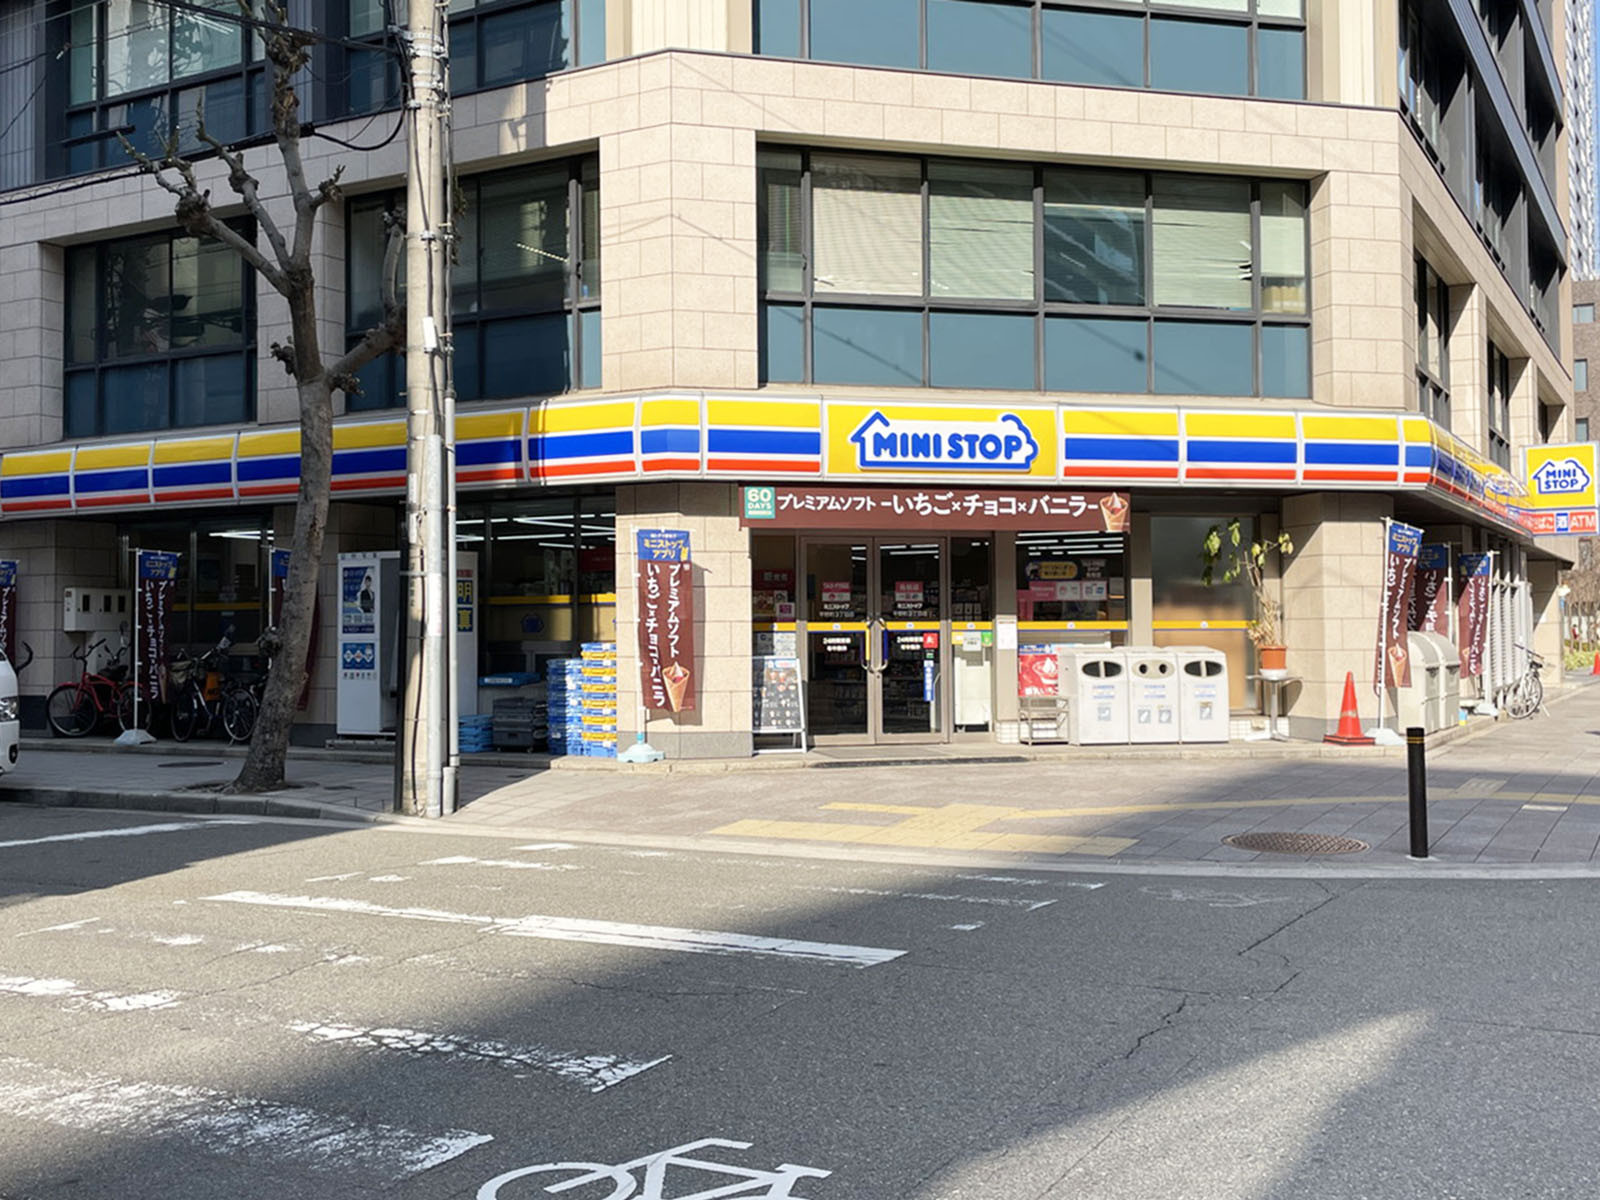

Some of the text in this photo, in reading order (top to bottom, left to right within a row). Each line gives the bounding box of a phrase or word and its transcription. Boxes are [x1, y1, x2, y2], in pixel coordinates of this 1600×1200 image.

[873, 432, 1021, 460] MINI STOP
[1545, 469, 1577, 479] MINI
[1544, 479, 1579, 490] STOP
[747, 488, 772, 503] 60
[777, 493, 877, 511] プレミアムソフト
[1570, 515, 1595, 530] ATM
[643, 538, 684, 550] ミニストップ
[652, 549, 676, 559] アプリ
[667, 563, 681, 658] プレミアムソフト
